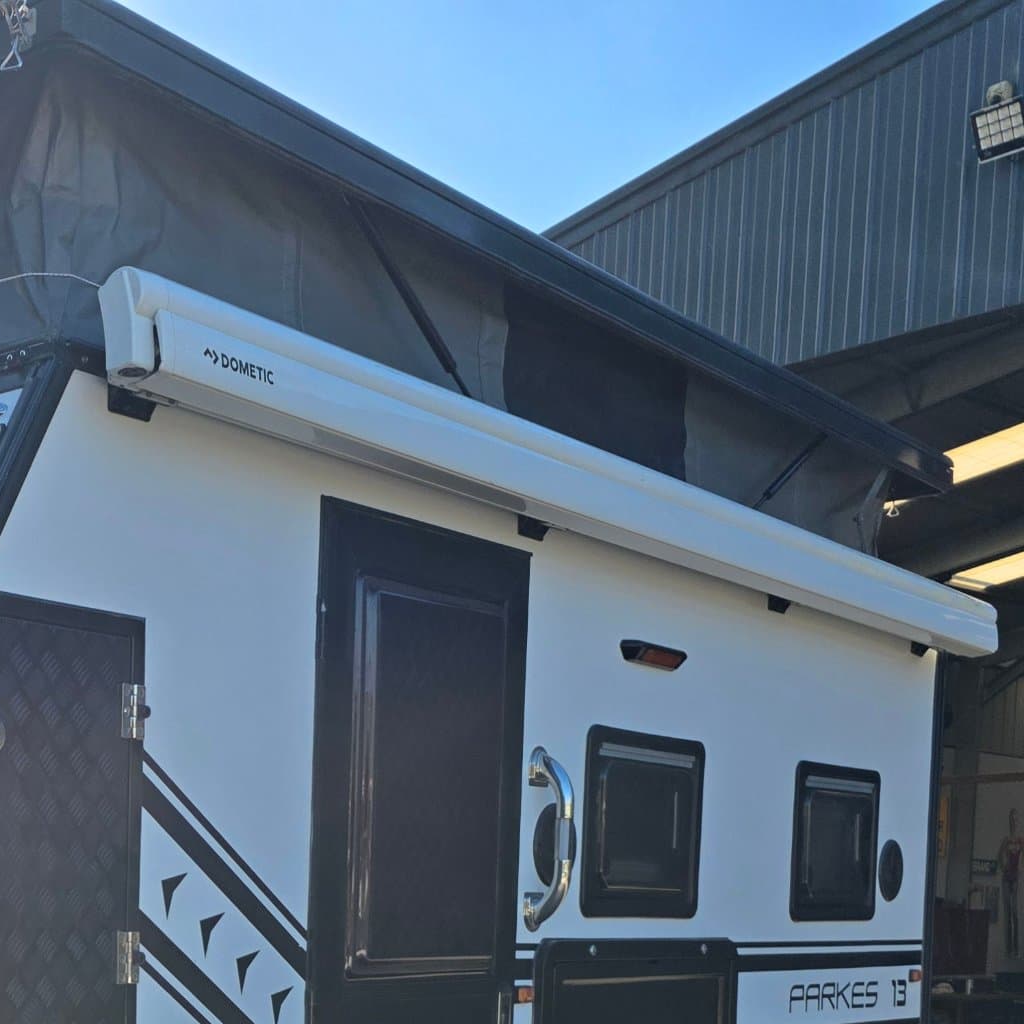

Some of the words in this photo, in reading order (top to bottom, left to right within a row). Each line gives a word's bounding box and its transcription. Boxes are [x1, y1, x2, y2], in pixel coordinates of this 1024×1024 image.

[220, 352, 274, 385] DOMETIC
[788, 981, 878, 1013] PARKES
[891, 979, 907, 1006] 13
